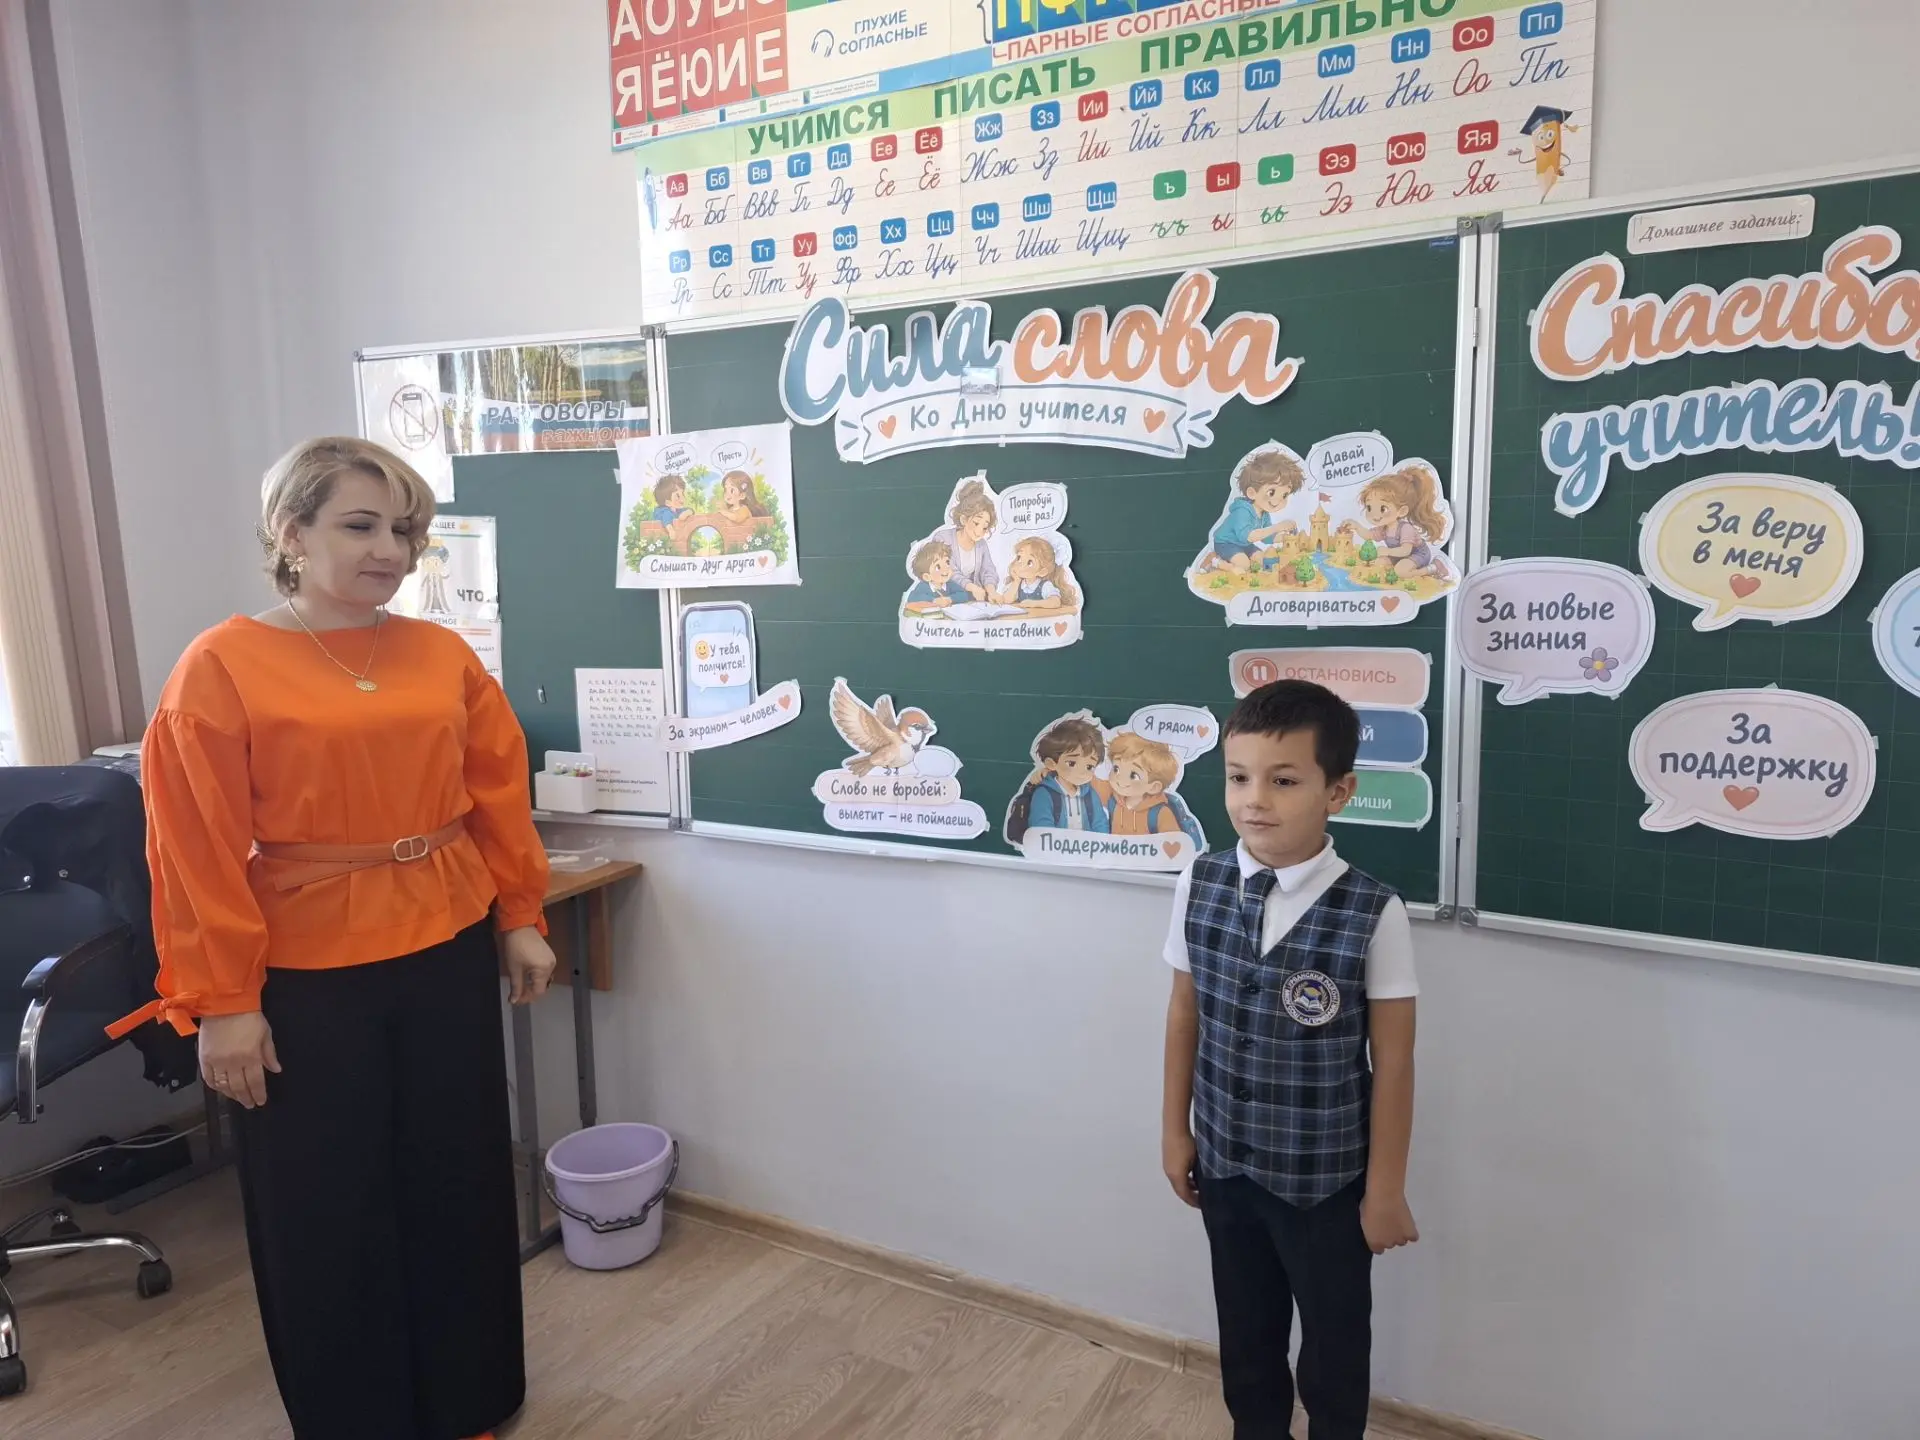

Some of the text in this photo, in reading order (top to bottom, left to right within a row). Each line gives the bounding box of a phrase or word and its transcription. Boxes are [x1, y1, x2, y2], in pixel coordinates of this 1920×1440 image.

[854, 9, 908, 34] ГЛУХИЕ
[838, 22, 928, 55] СОГЛАСНЫЕ
[1007, 22, 1109, 61] ПАРНЫЕ
[670, 13, 1556, 194] Аа Бб Вв Гг Дд Ее Ёё Жж Зз Ии Йй Кк Лл Мм Нн Оо Пп
[748, 99, 889, 156] УЧИМСЯ
[934, 56, 1097, 119] ПИСАТЬ
[672, 256, 687, 271] Рр
[712, 251, 729, 263] Сс
[756, 244, 771, 258] Тт
[797, 239, 813, 254] Уу
[835, 231, 856, 248] Фф
[885, 225, 903, 240] Хх
[931, 218, 951, 235] Цц
[976, 209, 995, 224] Чч
[1024, 201, 1051, 217] Шш
[1087, 190, 1116, 209] Щщ
[1325, 153, 1350, 170] Ээ
[1388, 141, 1425, 160] Юю
[1464, 129, 1492, 148] Яя
[1639, 212, 1803, 244] Домашнее задание:
[784, 272, 1294, 413] Сила слова
[910, 397, 1128, 431] Ко Дню учителя
[665, 456, 691, 471] обсудим
[718, 450, 742, 464] Прости
[1322, 444, 1365, 468] Давай
[1325, 456, 1376, 481] вместе!
[1009, 493, 1052, 511] Попробуй
[1013, 506, 1055, 525] ещё раз!
[1697, 502, 1827, 556] За веру
[650, 558, 755, 575] Слышать друг друга
[1693, 539, 1804, 578] в меня
[1476, 591, 1616, 624] За новые
[915, 622, 965, 639] Учитель
[984, 622, 1051, 639] наставник
[1486, 630, 1587, 652] знания
[719, 642, 740, 656] тебя
[1285, 667, 1397, 684] ОСТАНОВИСЬ
[669, 724, 685, 741] За
[688, 722, 729, 740] экраном
[739, 703, 778, 726] человек
[1144, 715, 1194, 735] Я рядом
[1726, 712, 1773, 745] За
[1658, 751, 1849, 797] поддержку
[831, 779, 947, 801] Слово не воробей:
[838, 808, 885, 821] вылетит
[900, 813, 913, 824] не
[916, 811, 974, 827] поймаешь
[1039, 832, 1158, 859] Поддерживать
